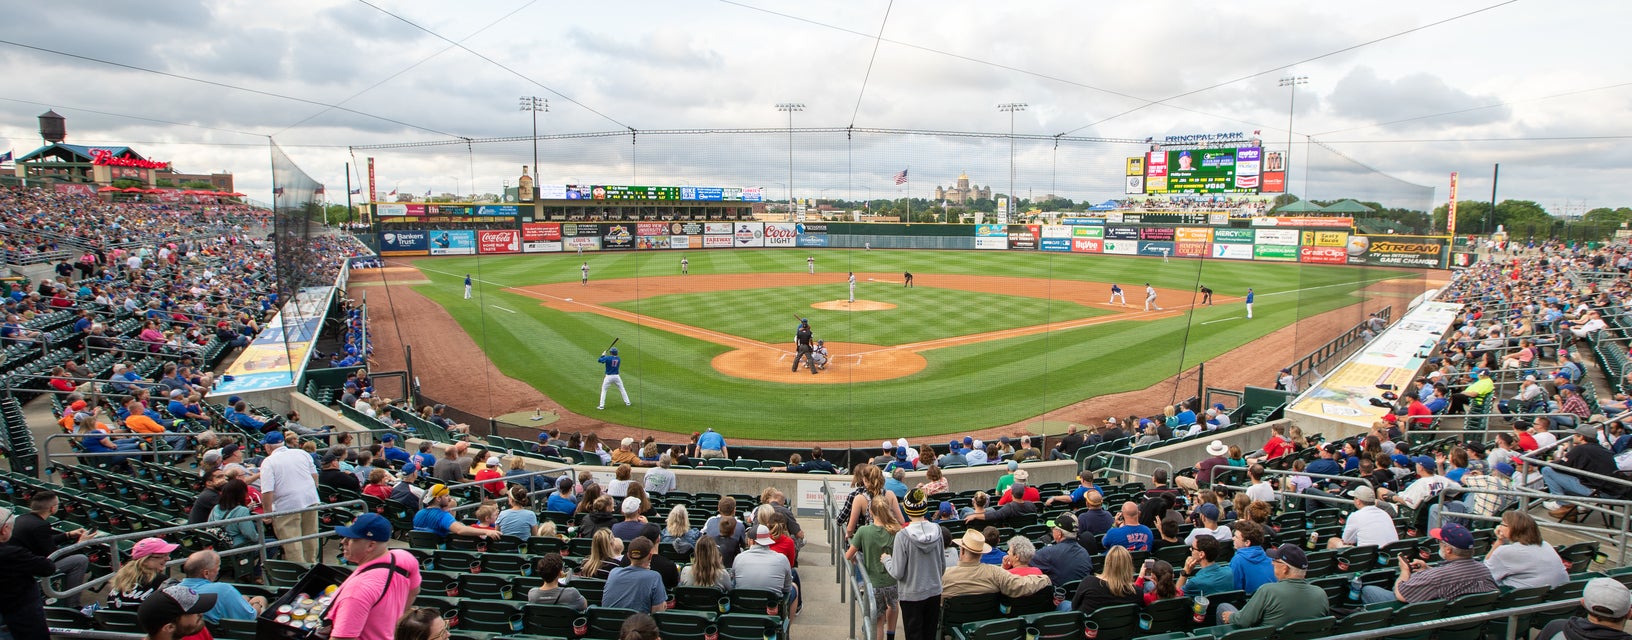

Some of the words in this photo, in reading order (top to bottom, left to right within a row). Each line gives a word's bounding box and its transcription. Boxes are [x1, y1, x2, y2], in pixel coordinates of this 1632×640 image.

[1166, 134, 1213, 142] PRINCIPAL
[88, 148, 168, 168] Budweiser
[482, 232, 511, 242] Coca-Cola
[765, 226, 796, 238] Coors
[1372, 242, 1440, 252] XTREAM
[1126, 533, 1148, 543] RIZZO
